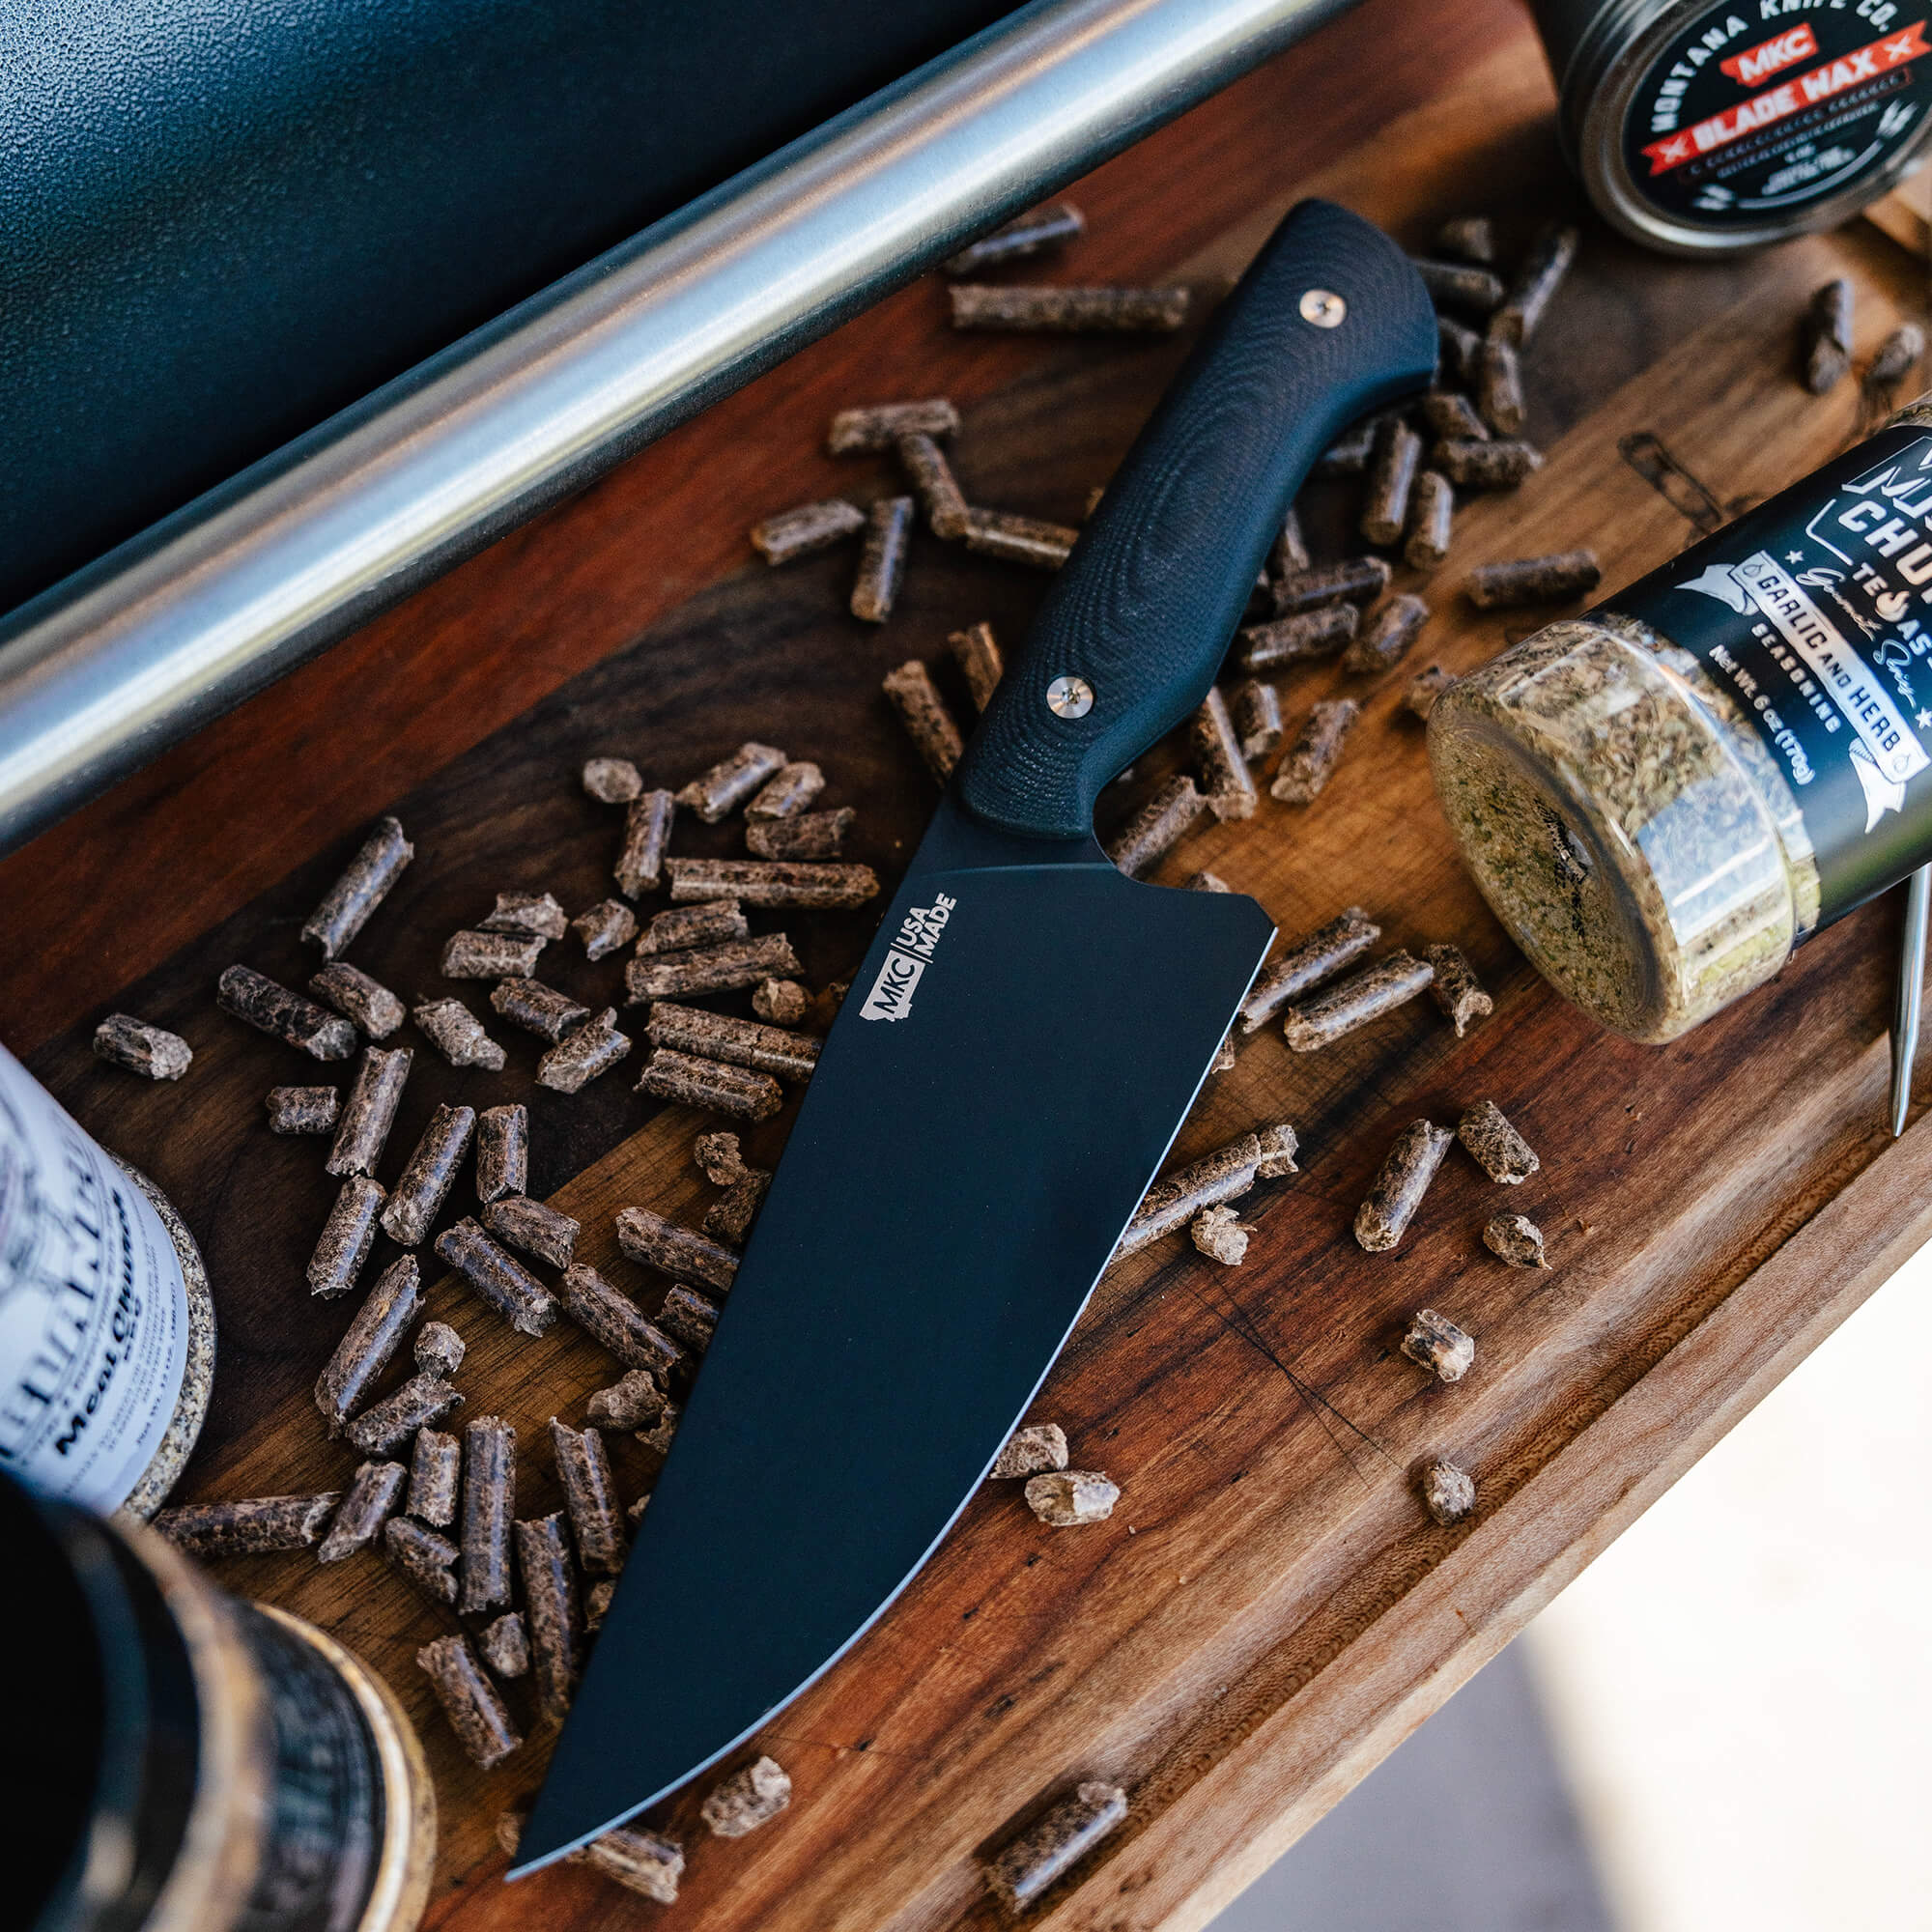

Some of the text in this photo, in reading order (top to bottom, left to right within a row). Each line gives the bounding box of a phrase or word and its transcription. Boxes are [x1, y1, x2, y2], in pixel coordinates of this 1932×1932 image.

[1651, 15, 1748, 132] MONTANA
[1856, 0, 1898, 32] CO.
[1692, 84, 1800, 151] BLADE
[1801, 49, 1880, 101] WAX
[1738, 30, 1814, 81] MKC
[1838, 499, 1932, 605] CHU
[1709, 644, 1738, 674] Net
[1753, 695, 1771, 711] 6
[1775, 728, 1816, 785] (170g)
[1751, 623, 1841, 733] SEASONING
[1756, 575, 1901, 752] GARLIC AND HERB
[895, 907, 930, 947] USA
[914, 893, 957, 956] MADE
[873, 958, 915, 1014] MKC
[55, 1350, 117, 1456] Meat
